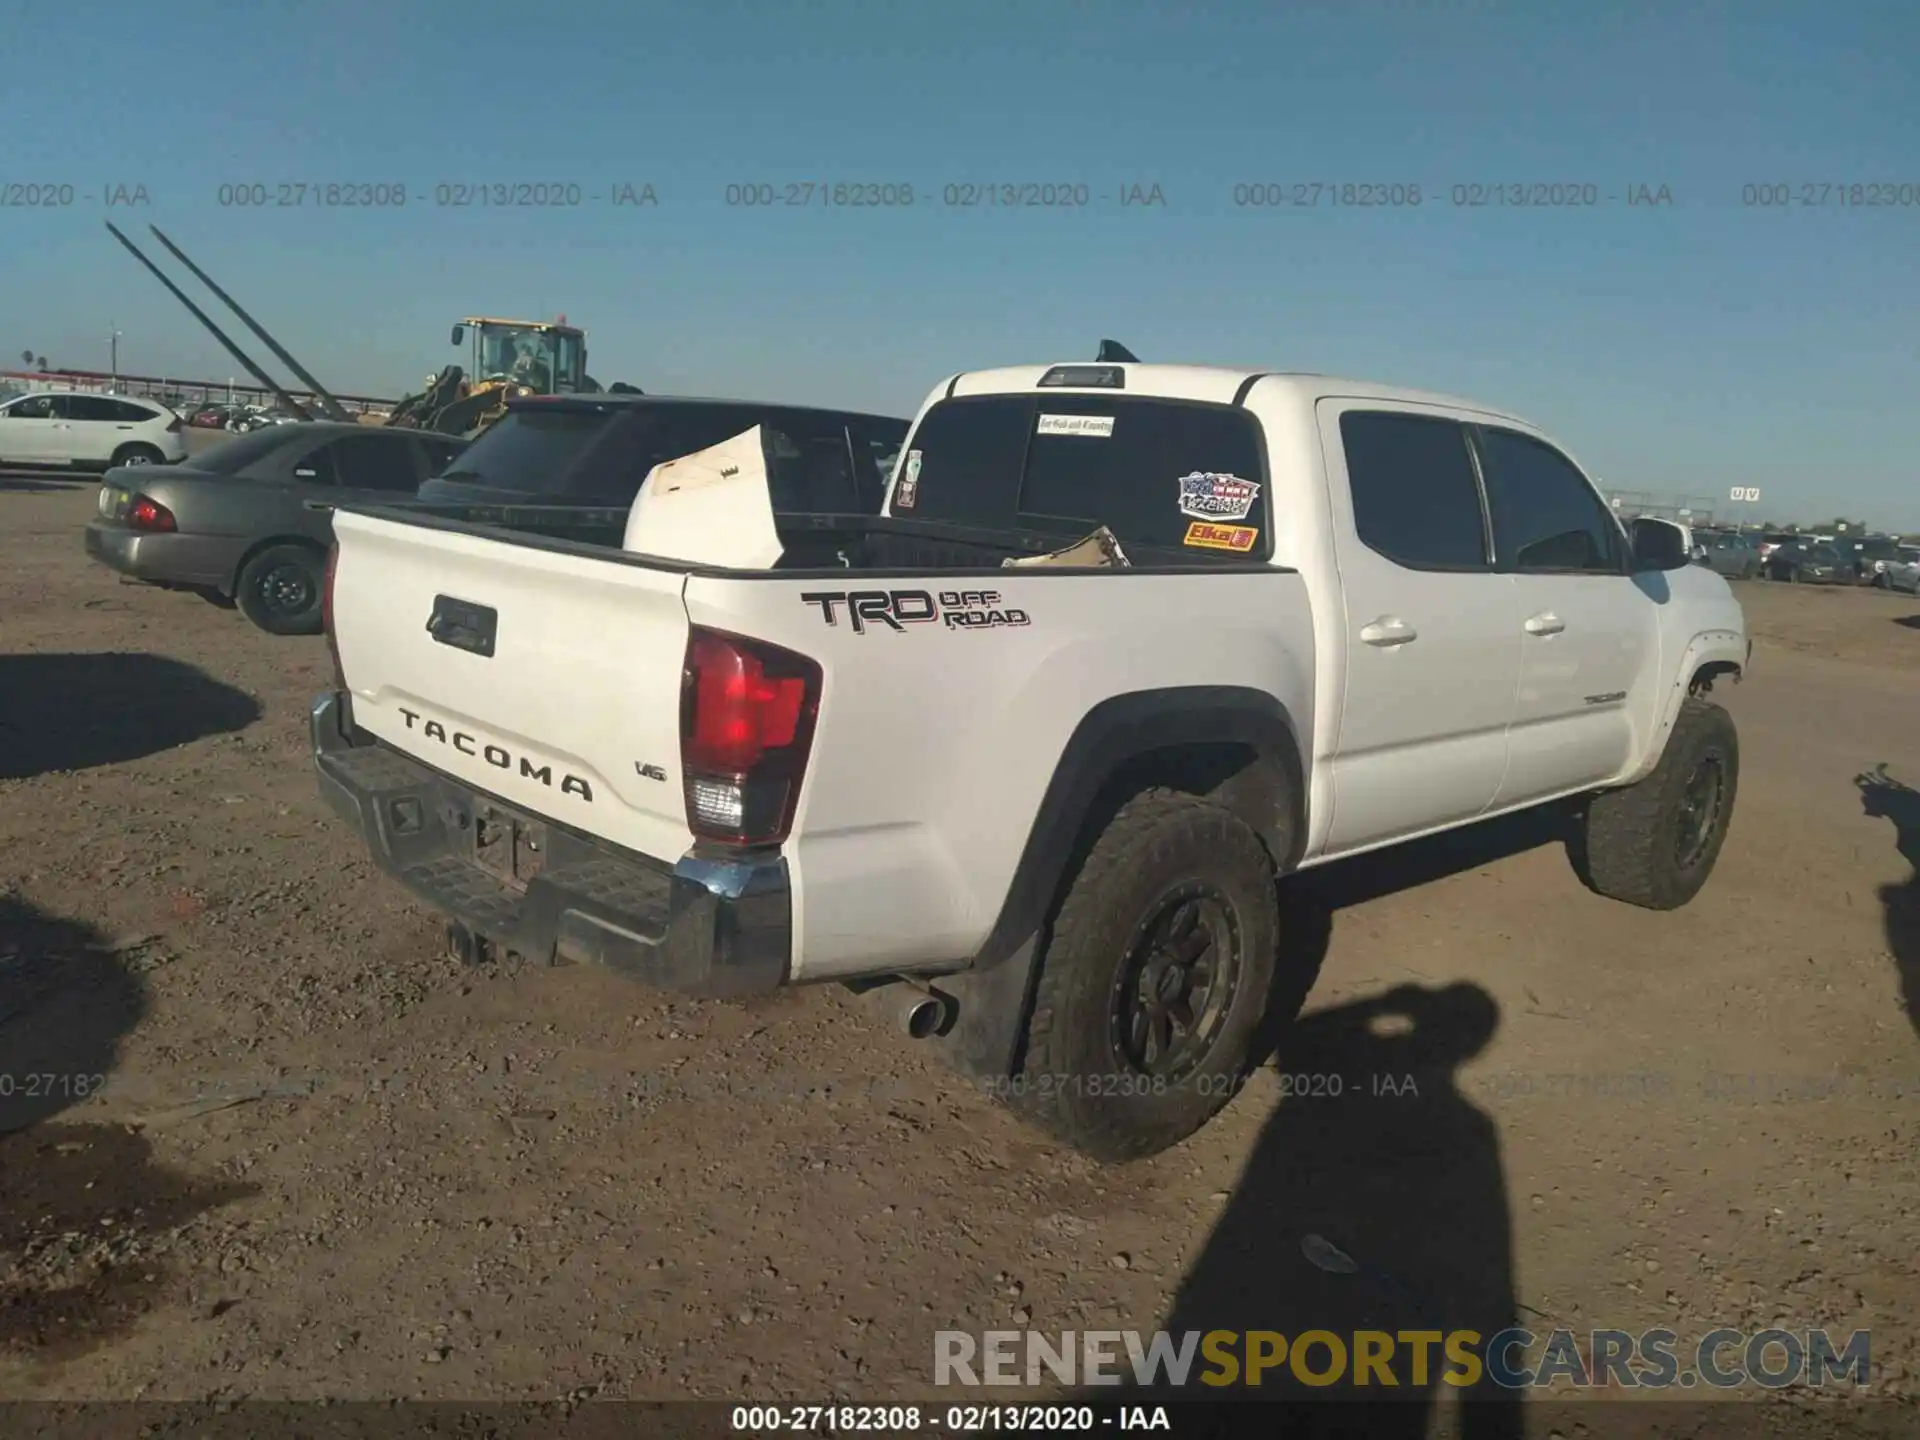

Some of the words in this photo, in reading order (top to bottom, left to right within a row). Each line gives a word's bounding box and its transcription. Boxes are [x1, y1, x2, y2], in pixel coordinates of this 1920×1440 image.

[800, 590, 938, 634] TRD
[938, 591, 1001, 609] OFF
[943, 608, 1031, 630] ROAD
[398, 707, 594, 802] TACOMA
